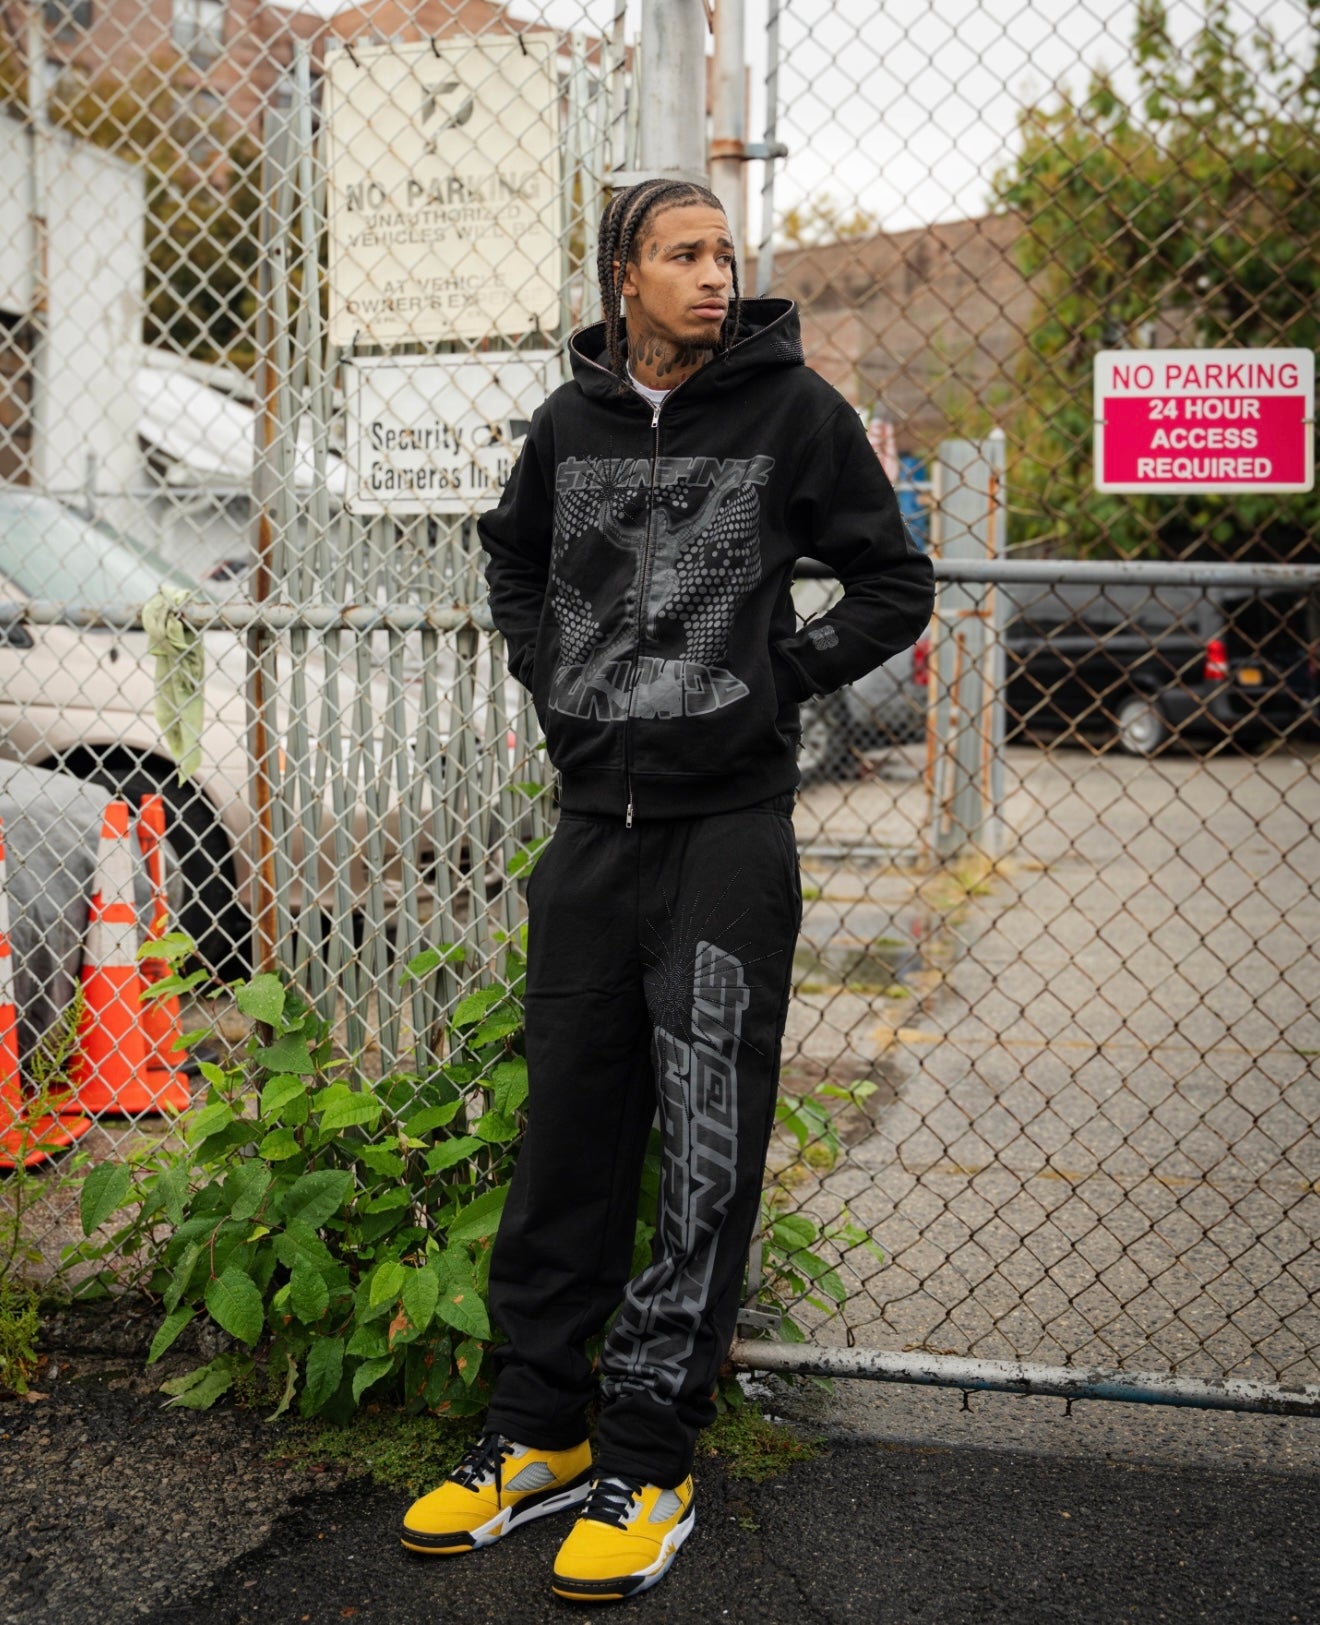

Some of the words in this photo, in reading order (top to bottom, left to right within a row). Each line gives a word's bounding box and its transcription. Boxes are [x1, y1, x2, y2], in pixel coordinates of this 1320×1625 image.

[346, 181, 386, 212] NO
[407, 171, 541, 207] PARKING
[366, 205, 522, 230] UNAUTHORIZD
[349, 227, 446, 248] VEHICLES
[384, 279, 407, 295] AT
[417, 273, 505, 292] VEHICE
[1112, 364, 1155, 390] NO
[1165, 362, 1299, 390] PARKING
[1148, 398, 1179, 420] 24
[1184, 398, 1261, 420] HOUR
[371, 420, 463, 455] Security
[1150, 428, 1258, 449] ACCESS
[371, 461, 462, 491] Cameras
[470, 460, 489, 489] In
[1136, 457, 1273, 480] REQUIRED
